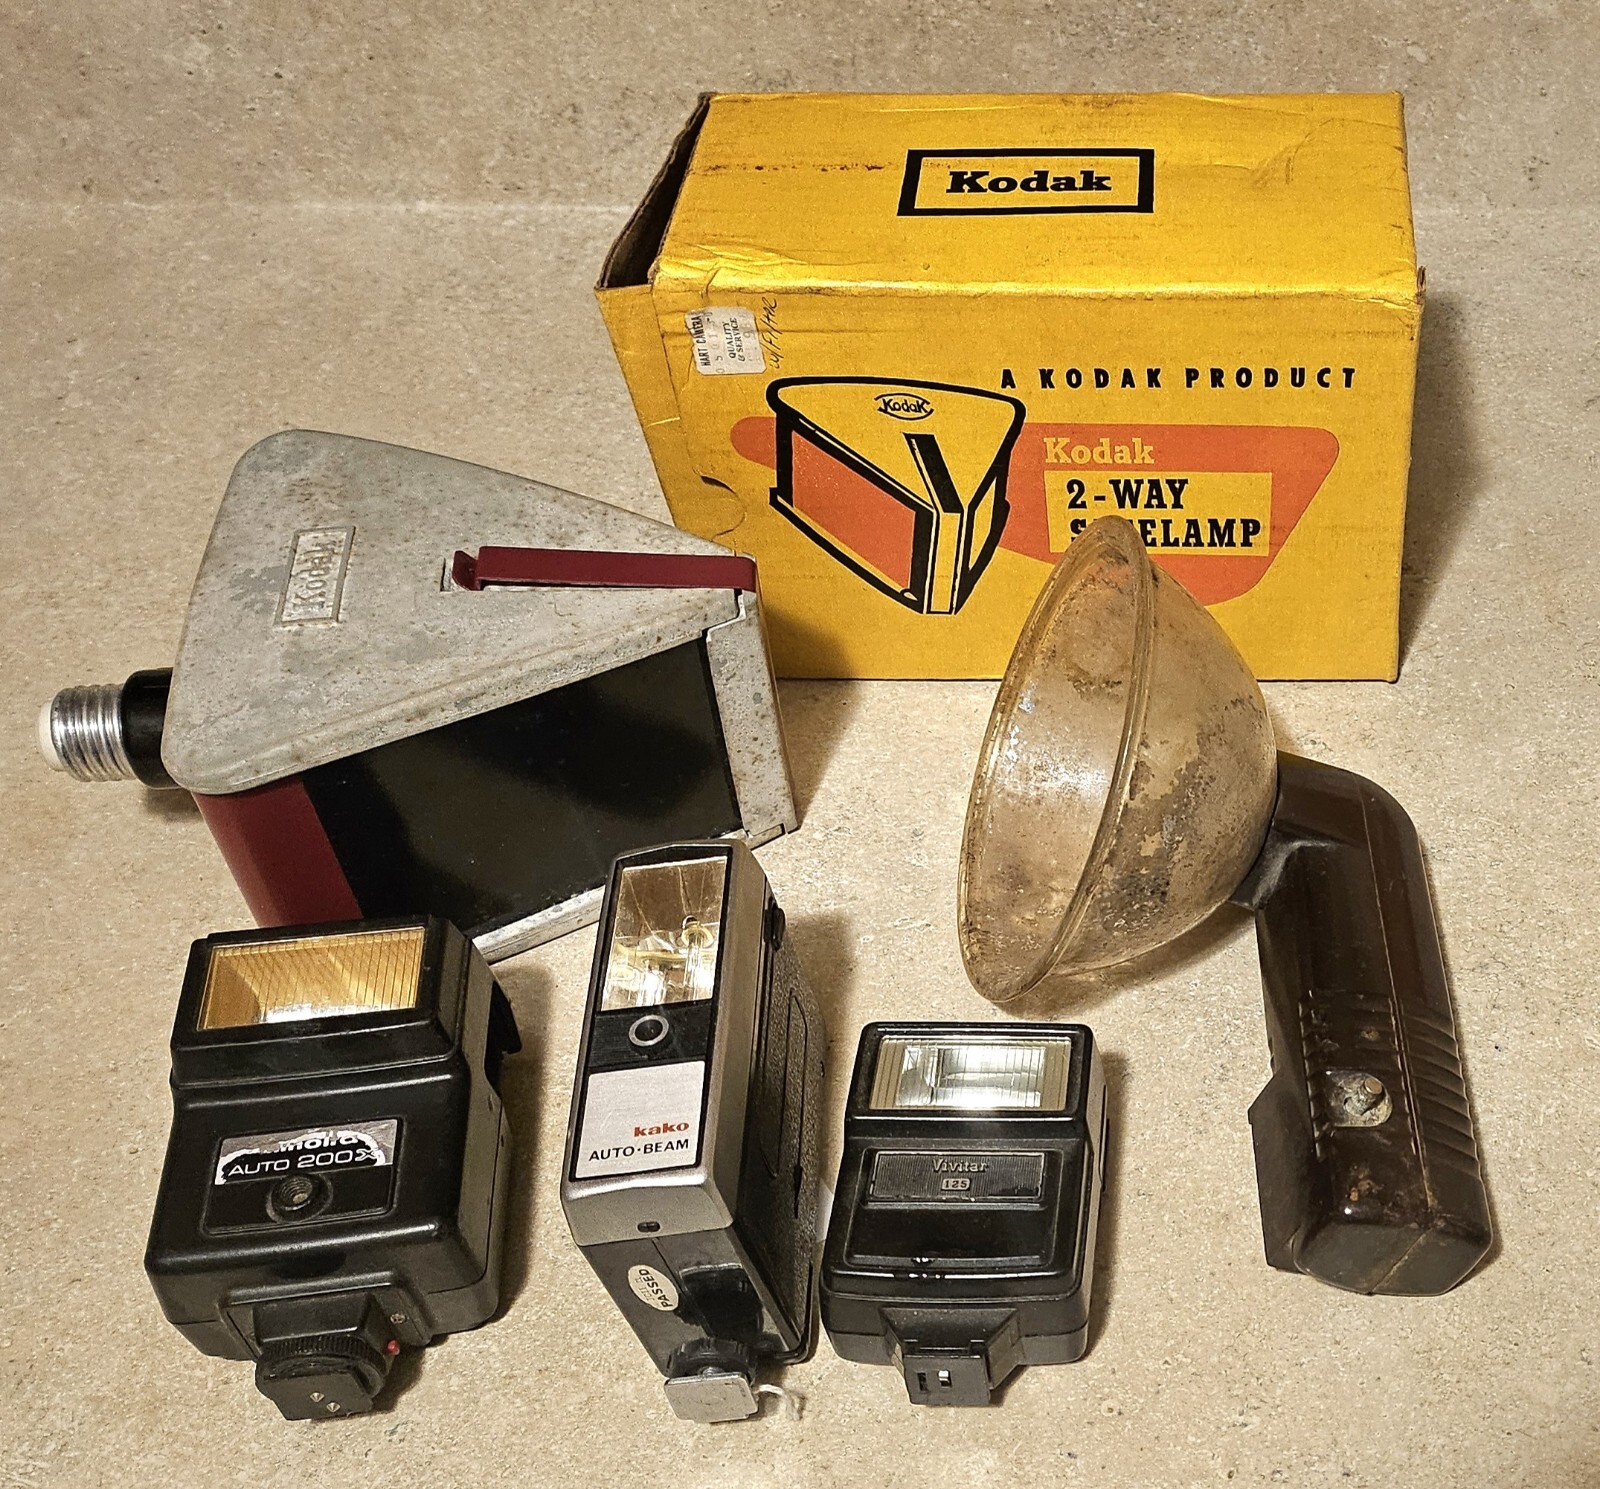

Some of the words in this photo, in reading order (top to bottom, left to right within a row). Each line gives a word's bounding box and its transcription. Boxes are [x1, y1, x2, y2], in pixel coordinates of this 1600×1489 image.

[946, 171, 1112, 193] Kodak
[722, 321, 737, 359] QUALITY
[730, 317, 742, 354] SERVICE
[698, 348, 711, 367] HART
[1001, 368, 1016, 389] A
[1039, 368, 1161, 389] KODAK
[1186, 368, 1355, 388] PRODUCT
[1043, 437, 1155, 464] Kodak
[1069, 518, 1262, 549] SELAMP
[634, 1122, 690, 1137] kako
[228, 1159, 290, 1177] AUTO
[933, 1158, 989, 1173] Vivitar
[943, 1179, 969, 1189] 125
[638, 1268, 674, 1308] PASSED
